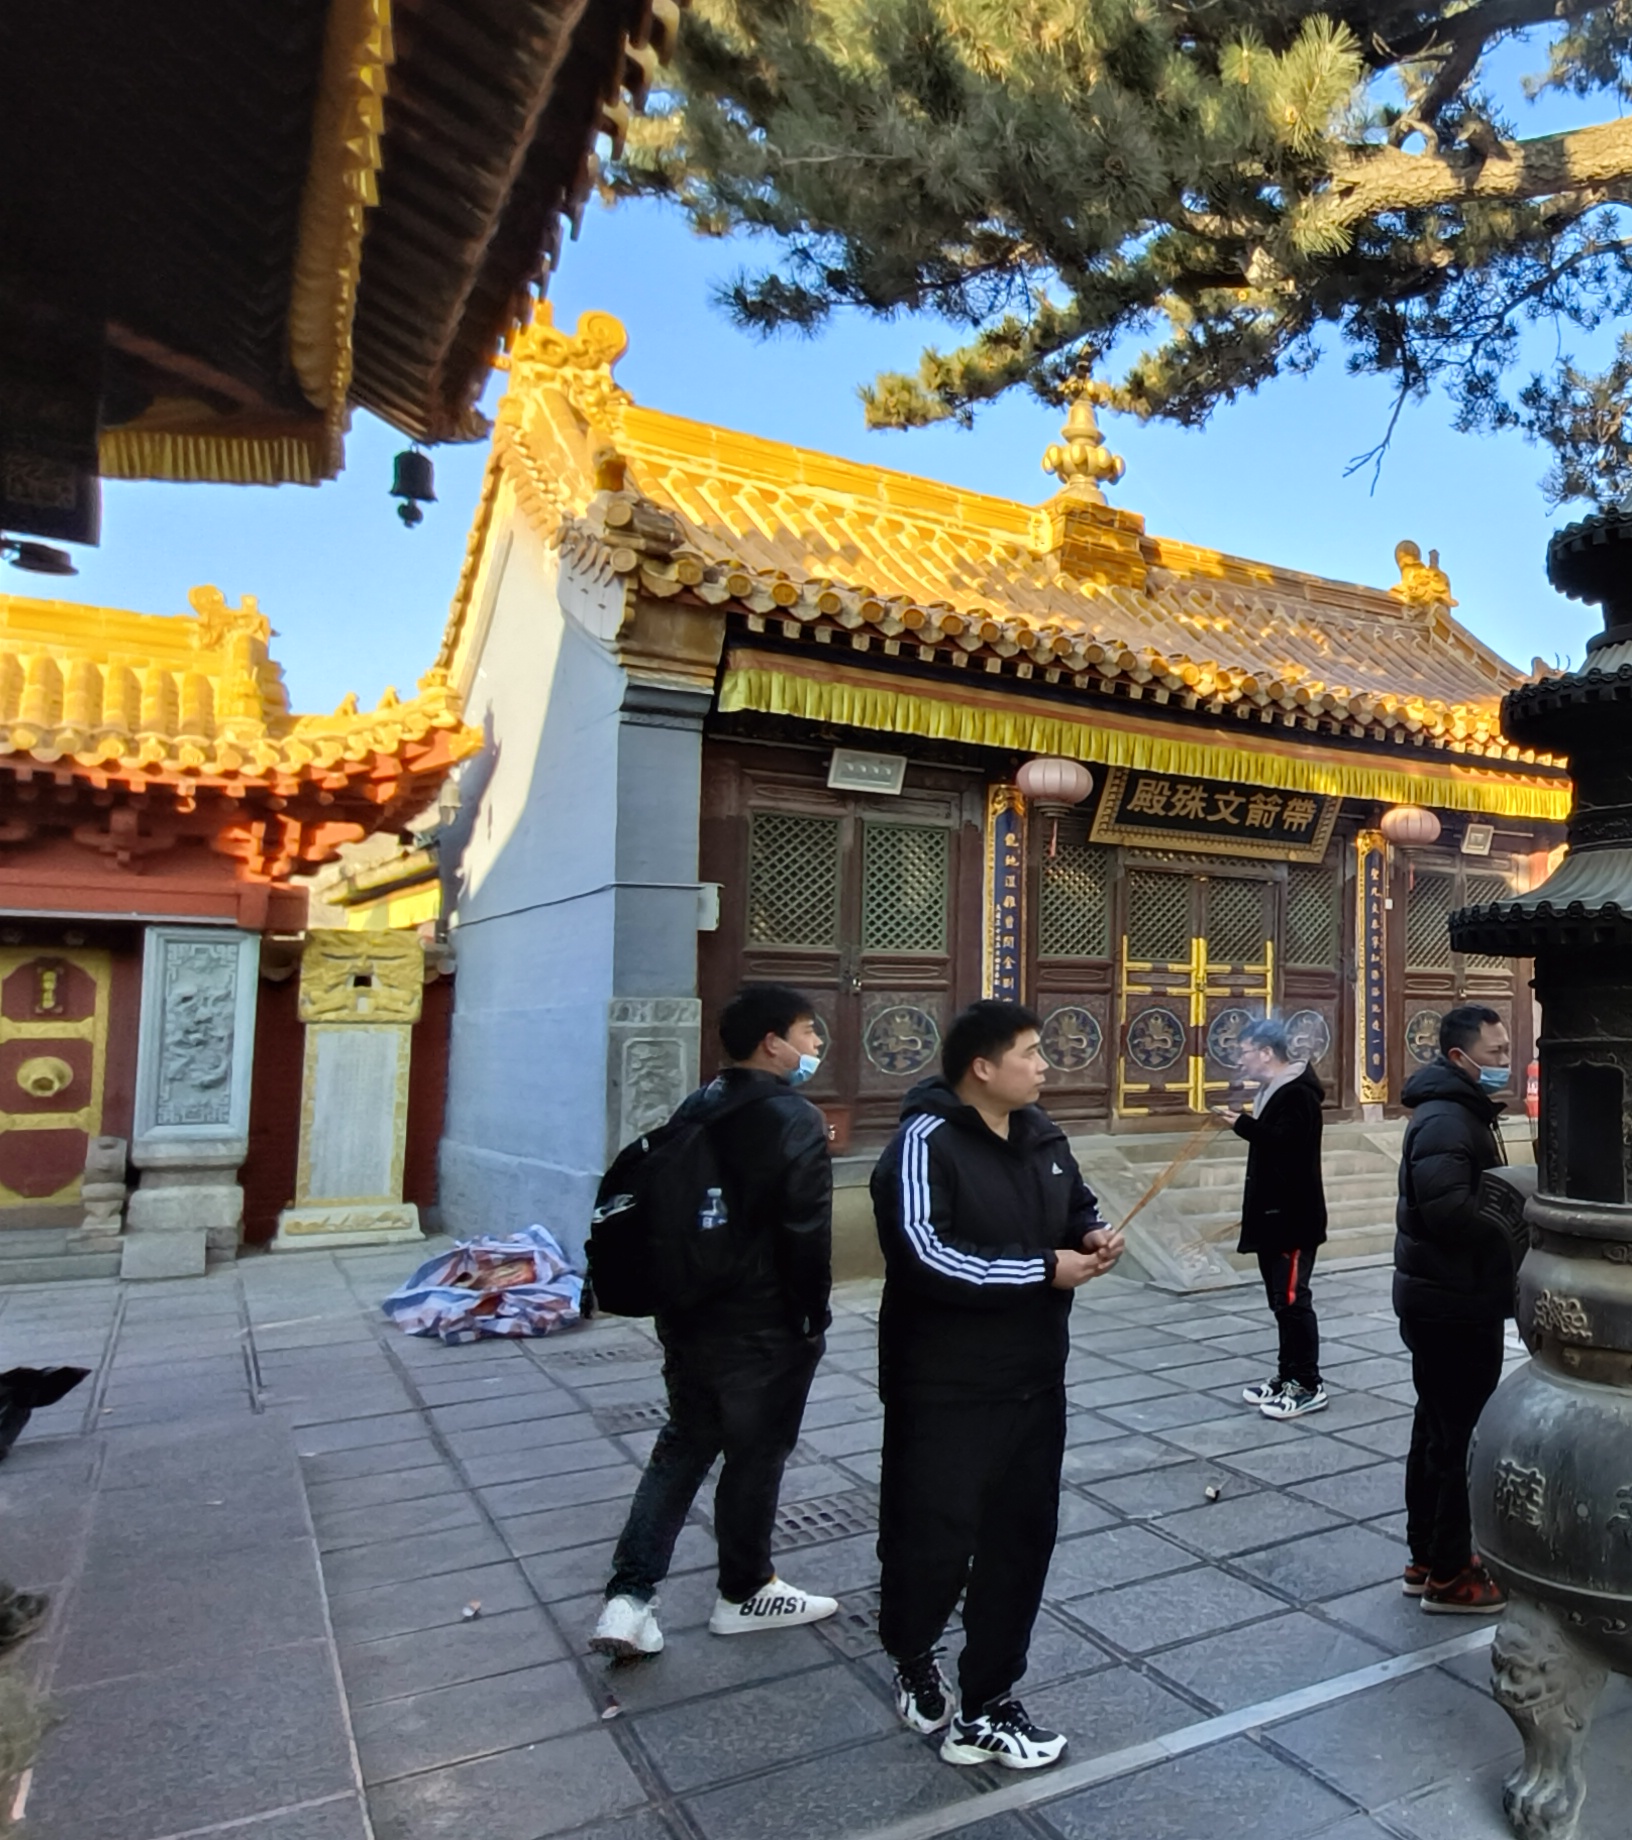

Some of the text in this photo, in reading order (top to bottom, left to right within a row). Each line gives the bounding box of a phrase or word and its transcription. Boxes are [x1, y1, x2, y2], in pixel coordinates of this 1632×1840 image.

[1126, 777, 1318, 833] 帶箭文殊殿
